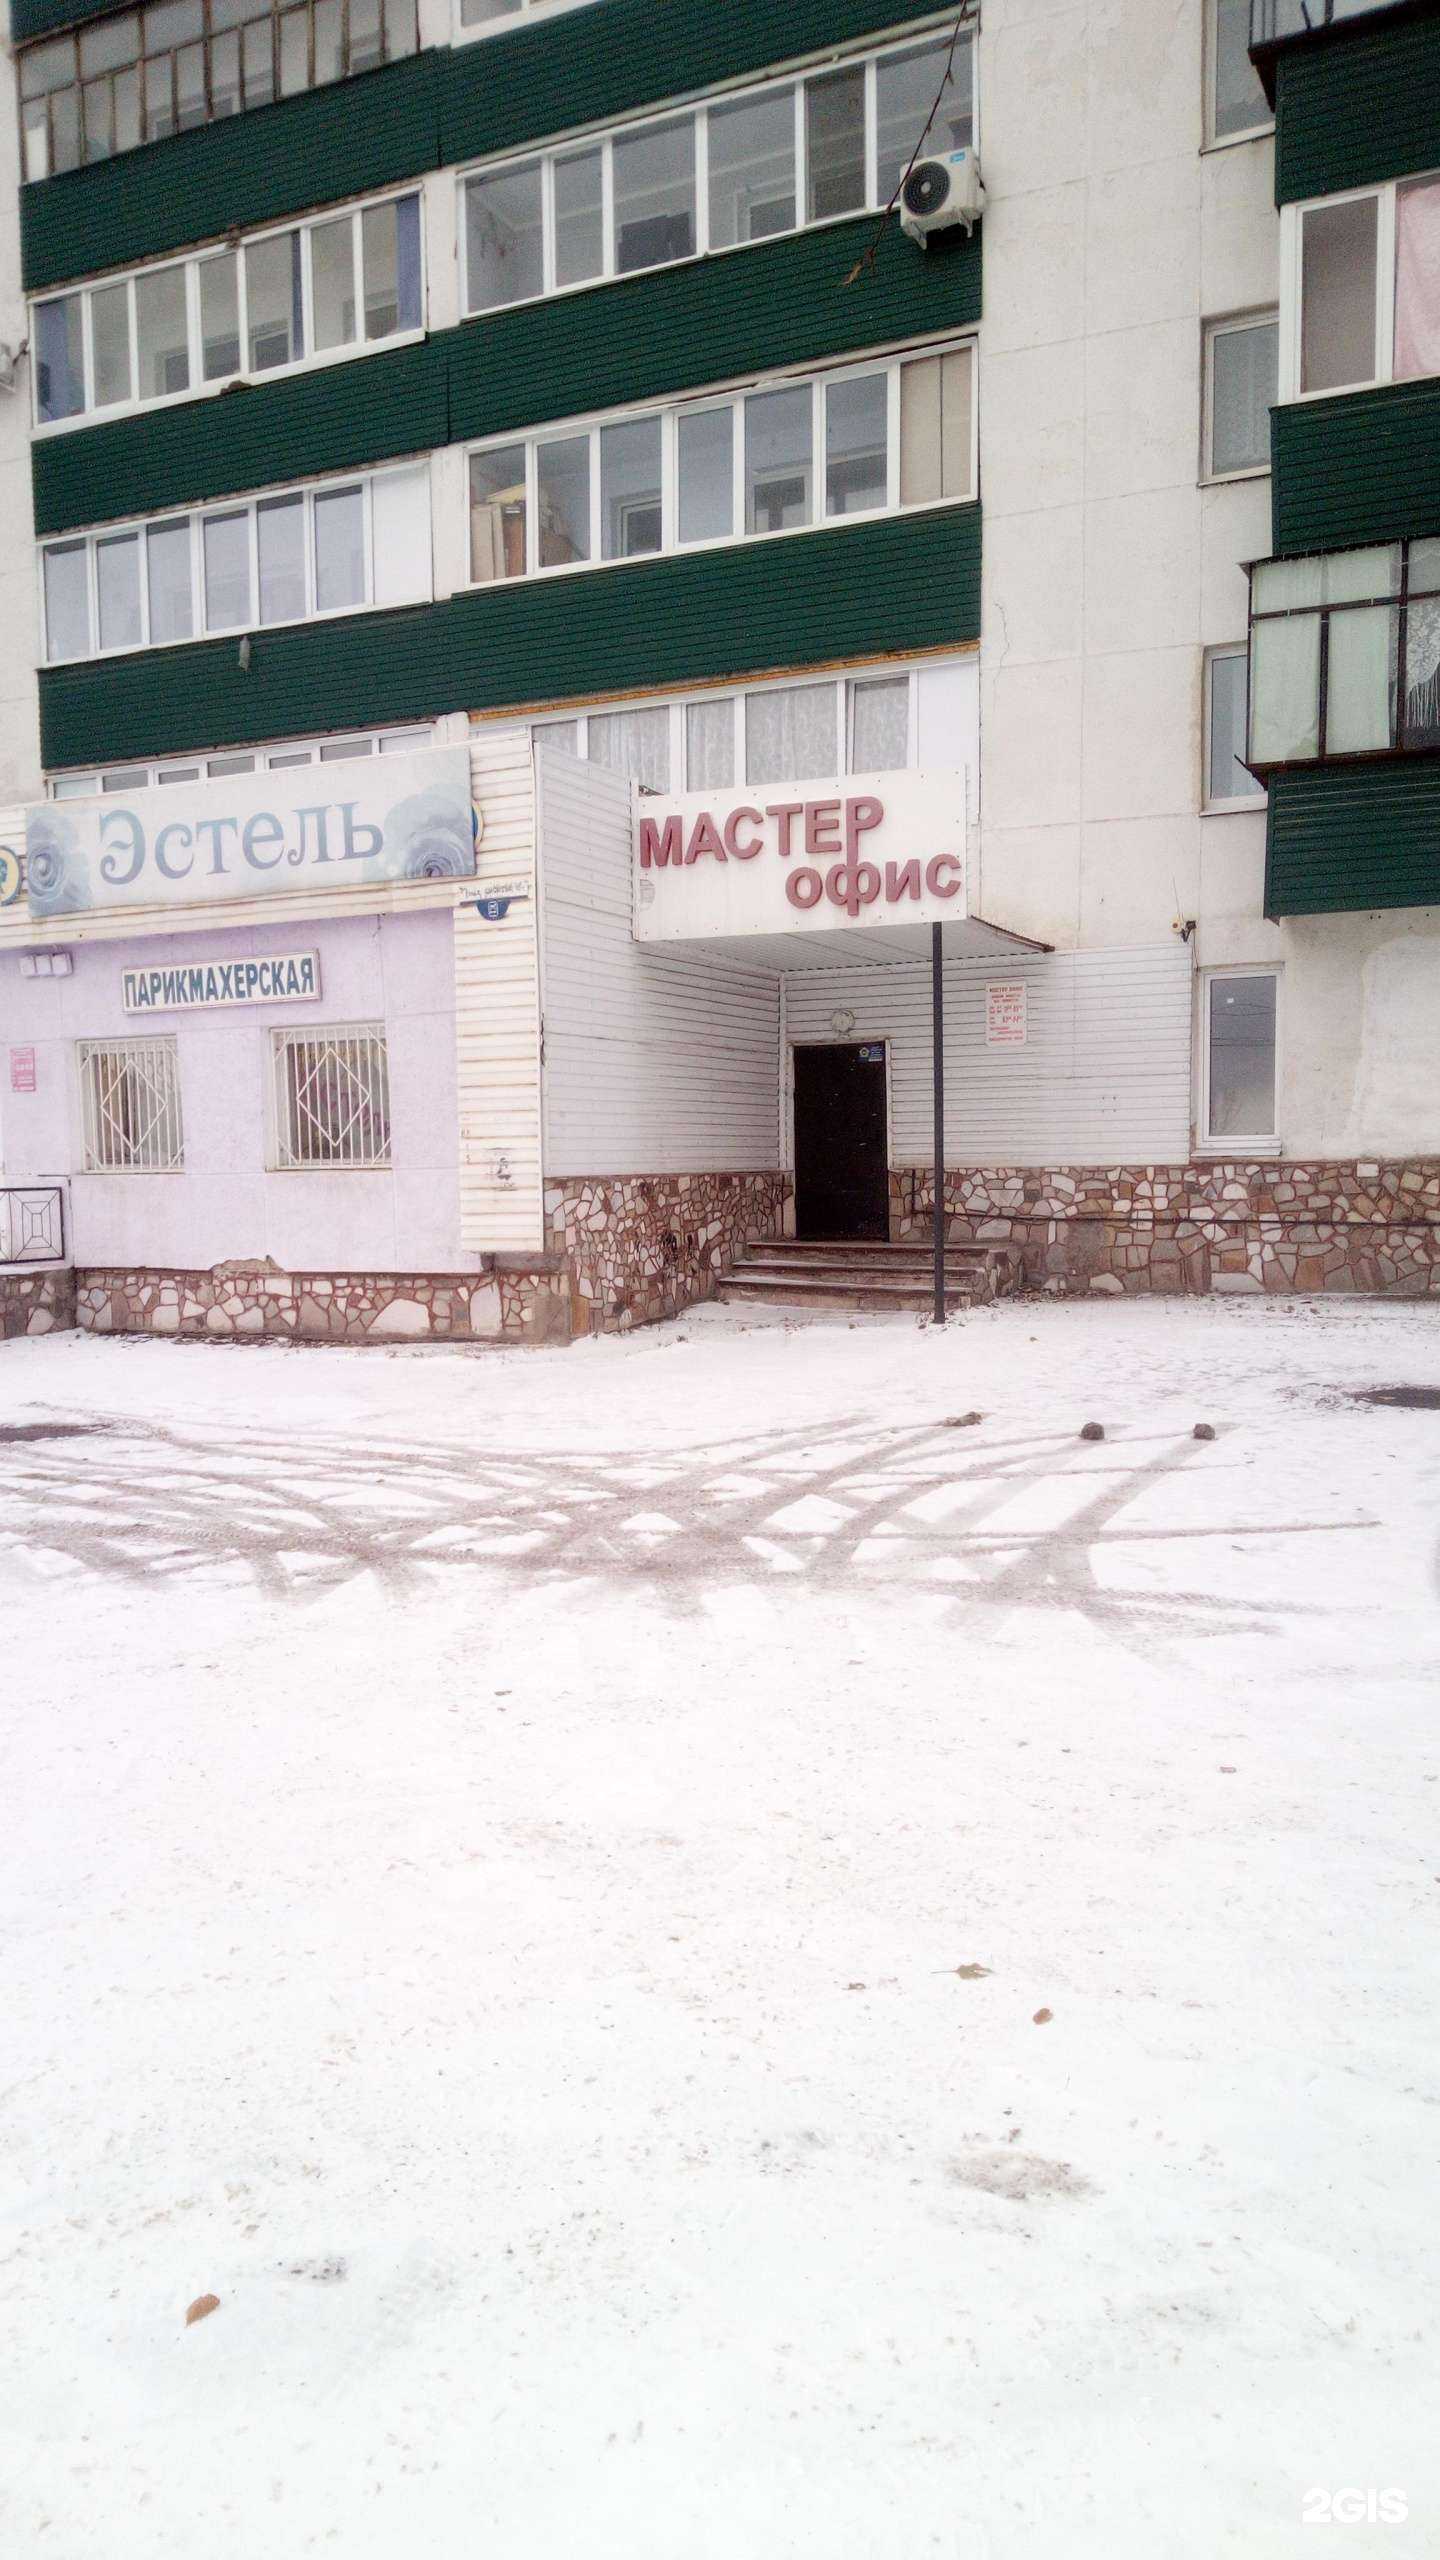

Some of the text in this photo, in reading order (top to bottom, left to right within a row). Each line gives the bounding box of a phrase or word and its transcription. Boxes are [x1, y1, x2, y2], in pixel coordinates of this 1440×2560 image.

[99, 802, 384, 885] Эстель
[638, 796, 884, 868] МАСТЕР
[124, 958, 315, 1008] ПАРИКМАХЕРСКАЯ
